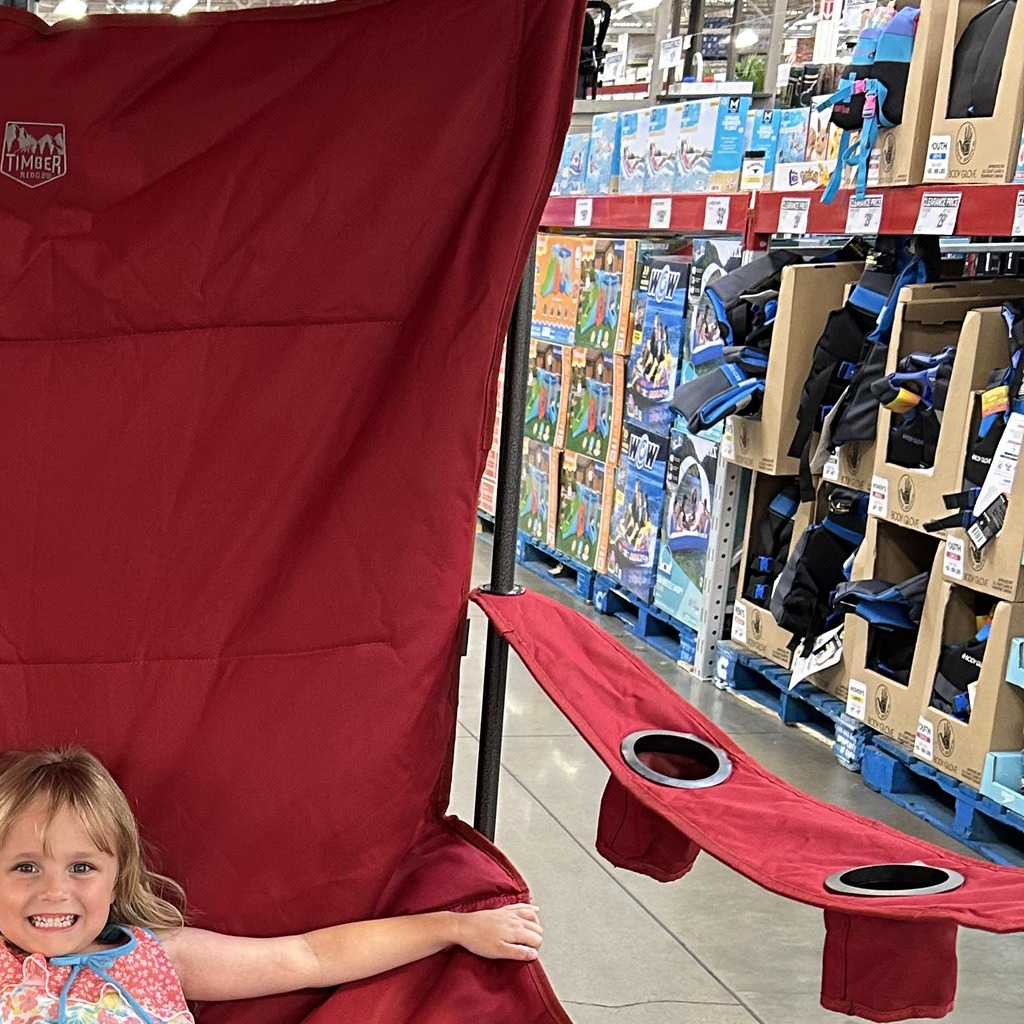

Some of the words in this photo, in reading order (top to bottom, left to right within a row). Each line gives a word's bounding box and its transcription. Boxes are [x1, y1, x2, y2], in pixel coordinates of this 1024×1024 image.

[5, 153, 62, 175] TIMBER
[961, 169, 978, 178] GLOVE
[19, 171, 46, 180] RIDGE
[647, 265, 681, 303] WOW
[628, 433, 660, 471] WOW
